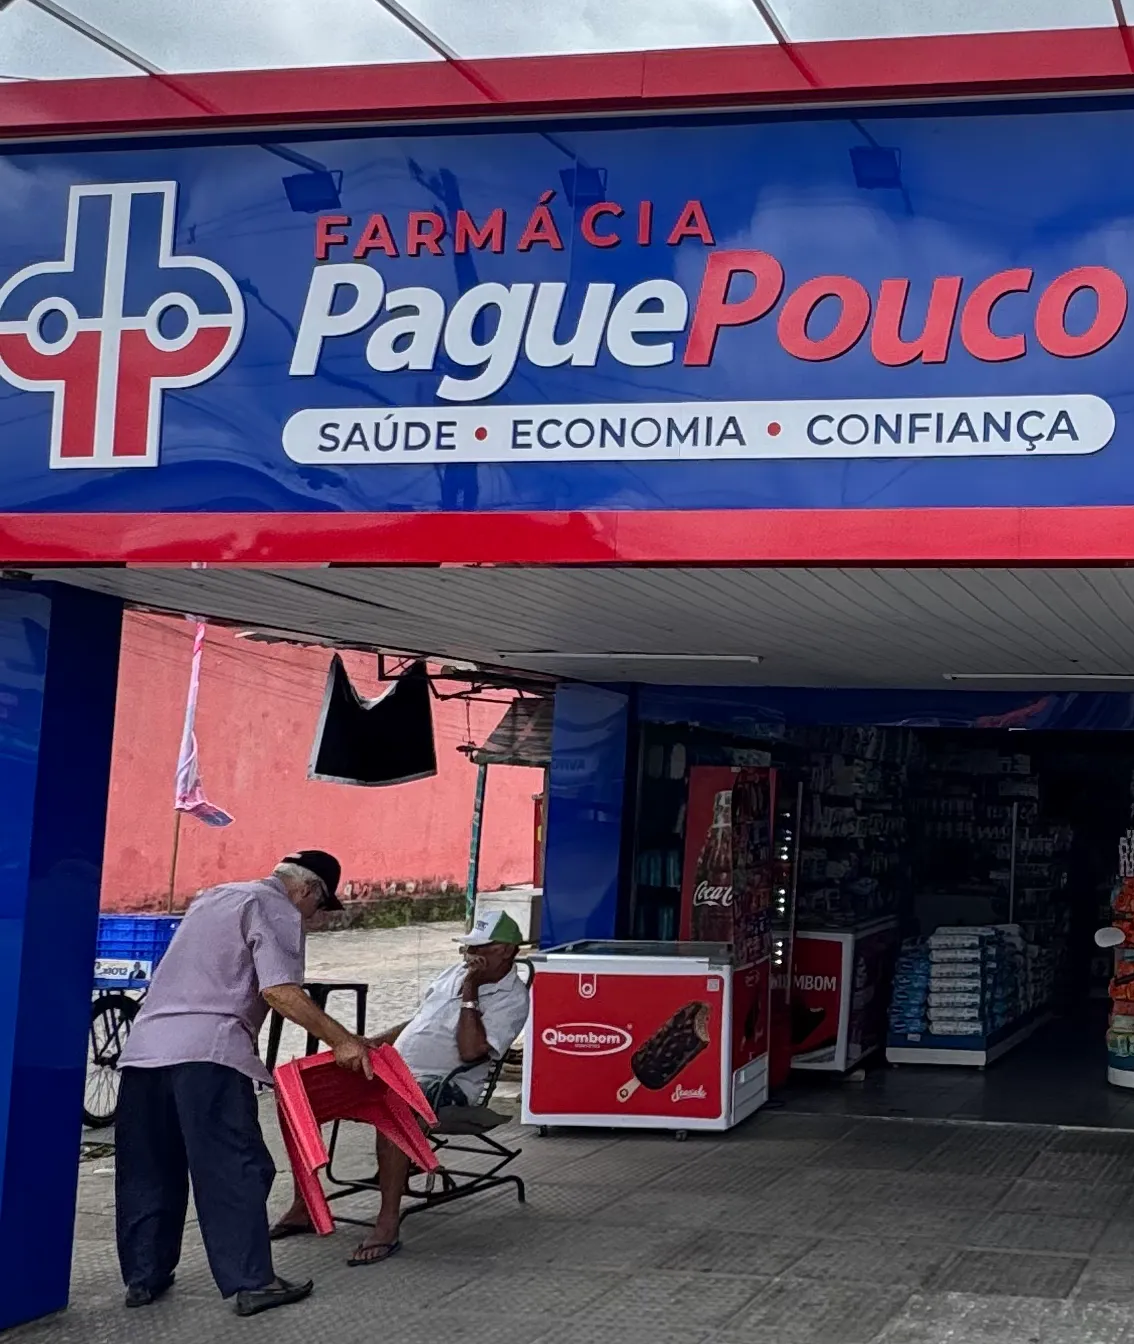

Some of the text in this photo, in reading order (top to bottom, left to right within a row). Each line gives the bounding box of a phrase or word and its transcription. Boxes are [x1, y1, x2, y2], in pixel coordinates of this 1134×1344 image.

[313, 190, 716, 260] FARMÁCIA
[317, 409, 1079, 454] SAÚDE ECONOMIA CONFIANÇA
[542, 1028, 620, 1046] Qbombom
